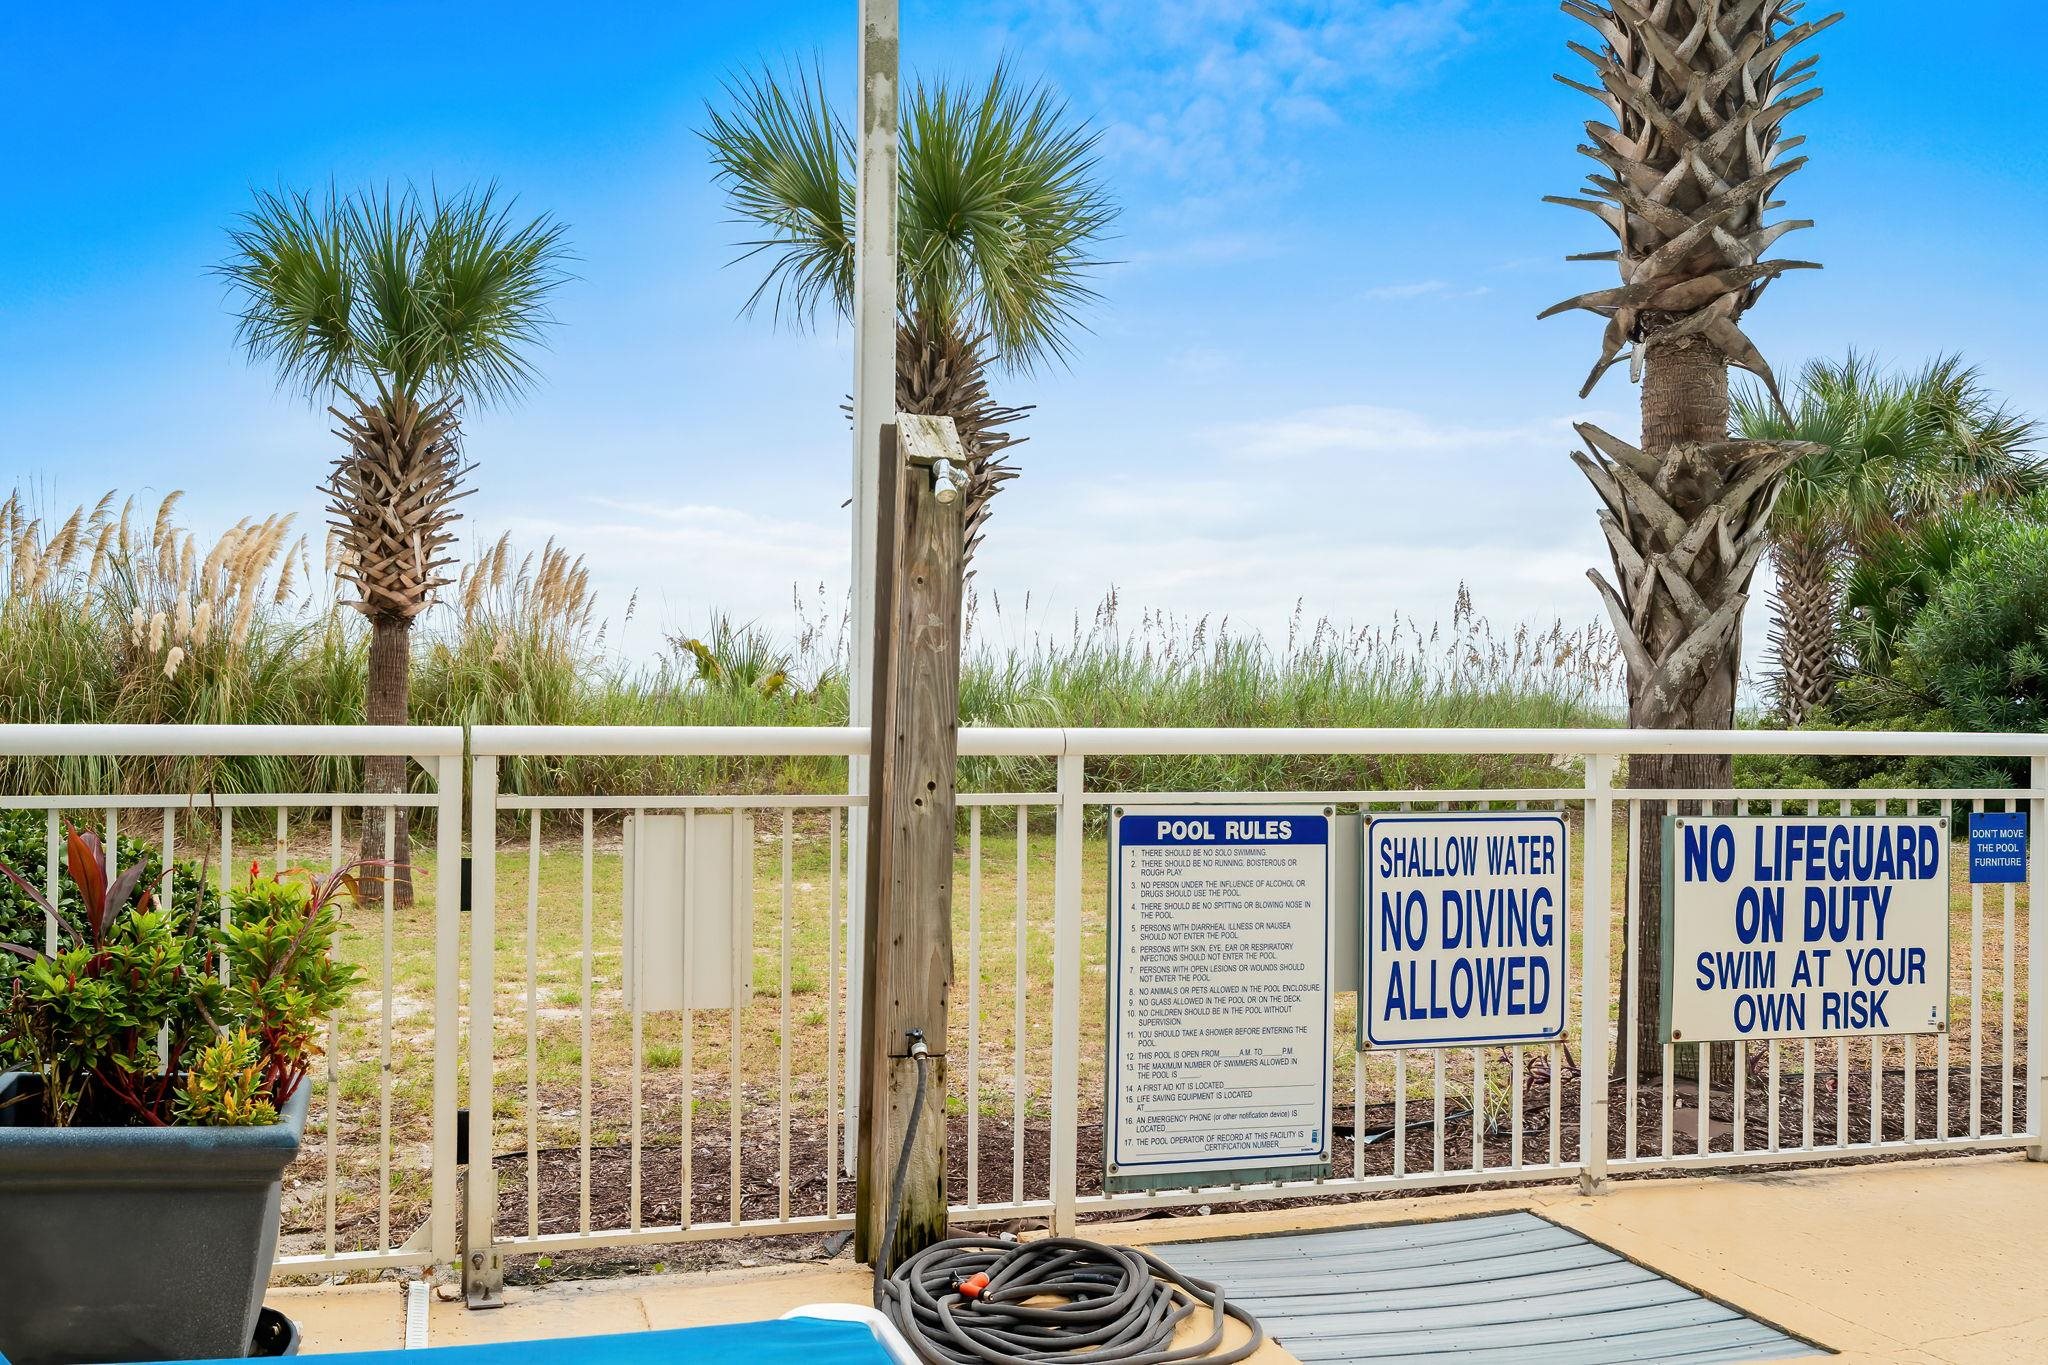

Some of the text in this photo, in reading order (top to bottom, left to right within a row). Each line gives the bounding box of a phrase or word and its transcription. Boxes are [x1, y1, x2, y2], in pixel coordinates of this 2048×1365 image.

[1157, 820, 1293, 841] POOL RULES
[1972, 829, 2024, 838] DON'T MOVE
[1140, 849, 1163, 857] THERE
[1164, 849, 1191, 857] SHOULD
[1977, 843, 2019, 852] THE POOL
[1380, 835, 1555, 879] SHALLOW WATER
[1685, 824, 1939, 883] NO LIFEGUARD
[1140, 860, 1163, 868] THERE
[1164, 859, 1191, 867] SHOULD
[1192, 859, 1201, 867] BE
[1203, 859, 1213, 867] NO
[1287, 858, 1297, 867] OR
[1975, 857, 2021, 867] FURNITURE
[1140, 881, 1151, 889] NO
[1152, 881, 1179, 889] PERSON
[1181, 881, 1204, 889] UNDER
[1219, 880, 1254, 888] INFLUENCE
[1265, 880, 1295, 888] ALCOHOL
[1140, 889, 1221, 898] DRUGS SHOULD USE THE
[1164, 902, 1191, 910] SHOULD
[1191, 902, 1201, 910] BE
[1213, 901, 1242, 909] SPITTING
[1243, 901, 1254, 909] OR
[1254, 901, 1284, 909] BLOWING
[1381, 887, 1553, 952] NO DIVING
[1735, 885, 1892, 944] ON DUTY
[1140, 924, 1172, 932] PERSONS
[1190, 923, 1227, 931] DIARRHEAL
[1227, 922, 1254, 930] ILLNESS
[1254, 922, 1265, 930] OR
[1265, 922, 1292, 930] NAUSEA
[1139, 932, 1219, 941] SHOULD NOT ENTER THE
[1139, 945, 1171, 953] PERSONS
[1172, 945, 1189, 953] WITH
[1239, 943, 1250, 951] OR
[1250, 943, 1294, 951] RESPIRATORY
[1139, 952, 1258, 962] INFECTIONS SHOULD NOT ENTER THE
[1139, 966, 1171, 974] PERSONS
[1172, 965, 1189, 973] WITH
[1190, 965, 1209, 973] OPEN
[1209, 964, 1237, 972] LESIONS
[1238, 964, 1249, 972] OR
[1279, 963, 1305, 971] SHOULD
[1696, 947, 1926, 991] SWIM AT YOUR
[1178, 974, 1191, 982] THE
[1139, 985, 1281, 996] NO ANIMALS OR PETS ALLOWED THE POOL
[1384, 955, 1550, 1021] ALLOWED
[1139, 995, 1282, 1007] NO GLASS ALLOWED THE POOL OR ON THE
[1138, 1005, 1293, 1017] NO CHILDREN SHOULD BE THE POOL WITHOUT
[1734, 990, 1889, 1034] OWN RISK
[1138, 1026, 1308, 1039] YOU SHOULD TAKE SHOWER BEFORE ENTERING THE
[1138, 1048, 1263, 1060] THIS POOL OPEN FROM TO
[1137, 1058, 1290, 1071] THE MAXIMUM SWIMMERS ALLOWED
[1137, 1071, 1170, 1080] THE POOL
[1143, 1081, 1225, 1092] FIRST AID KIT LOCATED
[1136, 1090, 1253, 1103] LIFE SAVING EQUIPMENT LOCATED
[1136, 1104, 1145, 1112] AT
[1136, 1116, 1146, 1124] AN
[1147, 1114, 1188, 1124] EMERGENCY
[1189, 1113, 1212, 1122] PHONE
[1222, 1112, 1238, 1120] other
[1239, 1110, 1269, 1119] notification
[1136, 1124, 1166, 1133] LOCATED
[1136, 1131, 1297, 1146] THE POOL OPERATOR RECORD AT THIS FACILITY
[1204, 1140, 1280, 1152] CERTIFICATION NUMBER
